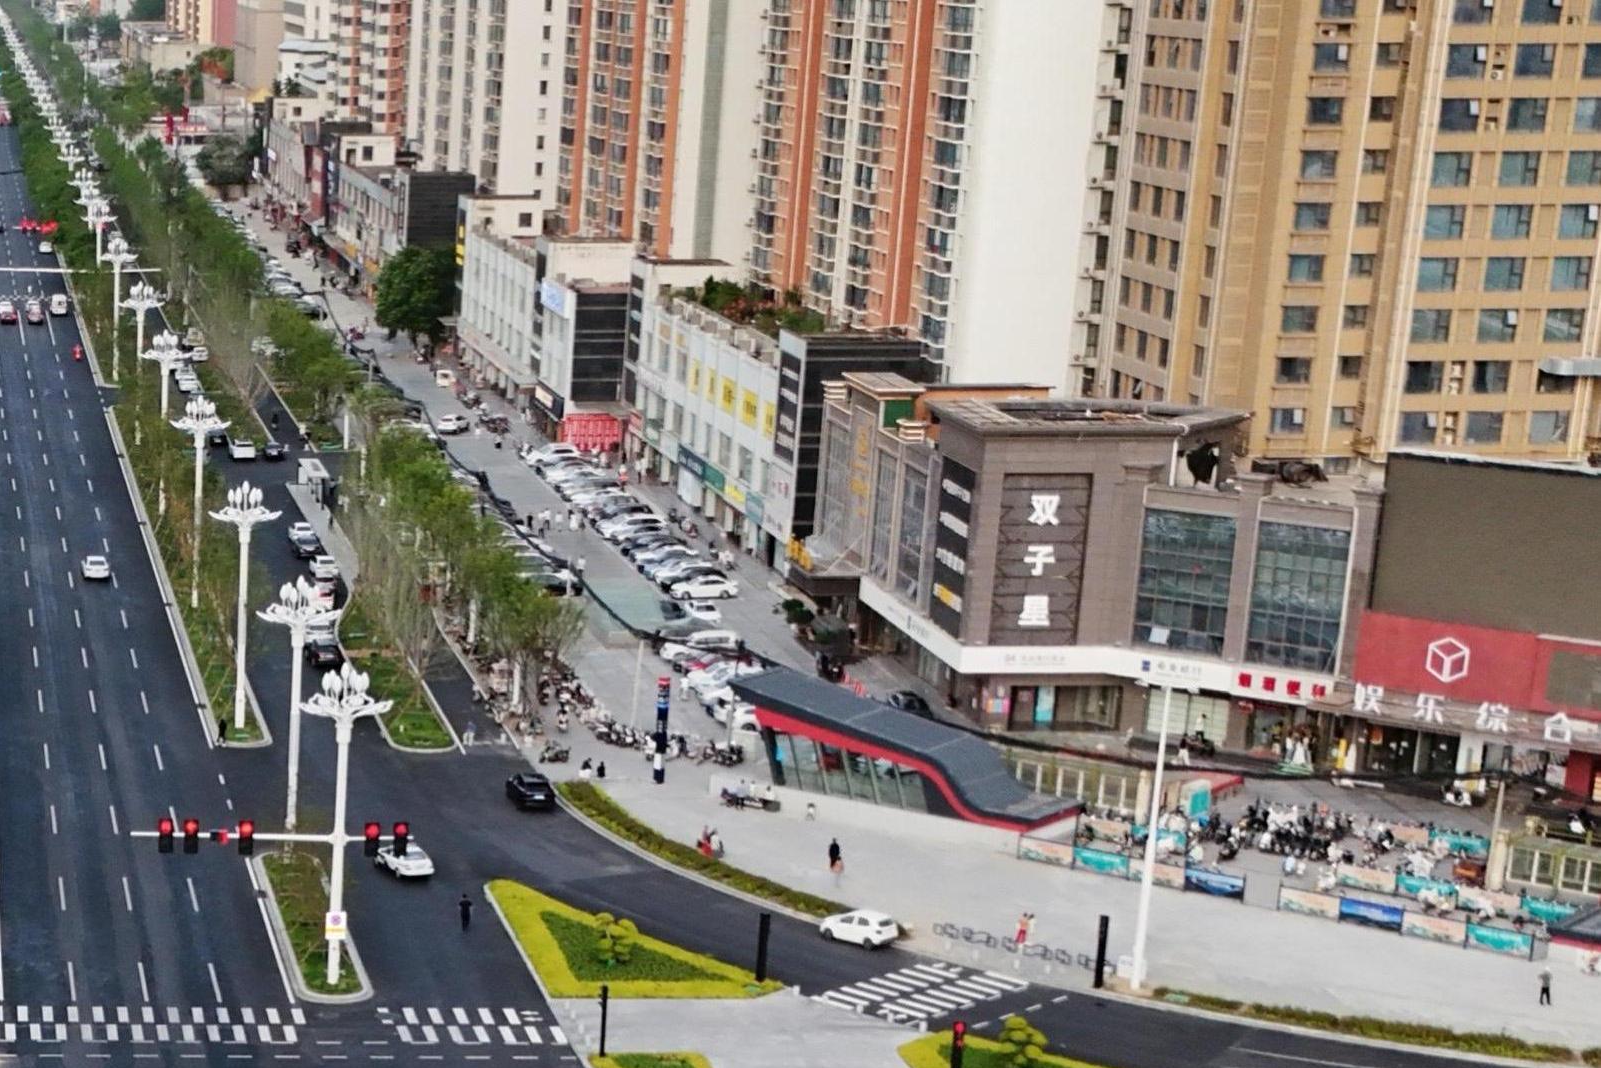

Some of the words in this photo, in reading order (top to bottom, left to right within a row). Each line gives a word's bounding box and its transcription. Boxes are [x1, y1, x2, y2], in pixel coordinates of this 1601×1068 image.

[1017, 494, 1061, 626] 双子星
[1353, 682, 1572, 744] 娱乐综合
